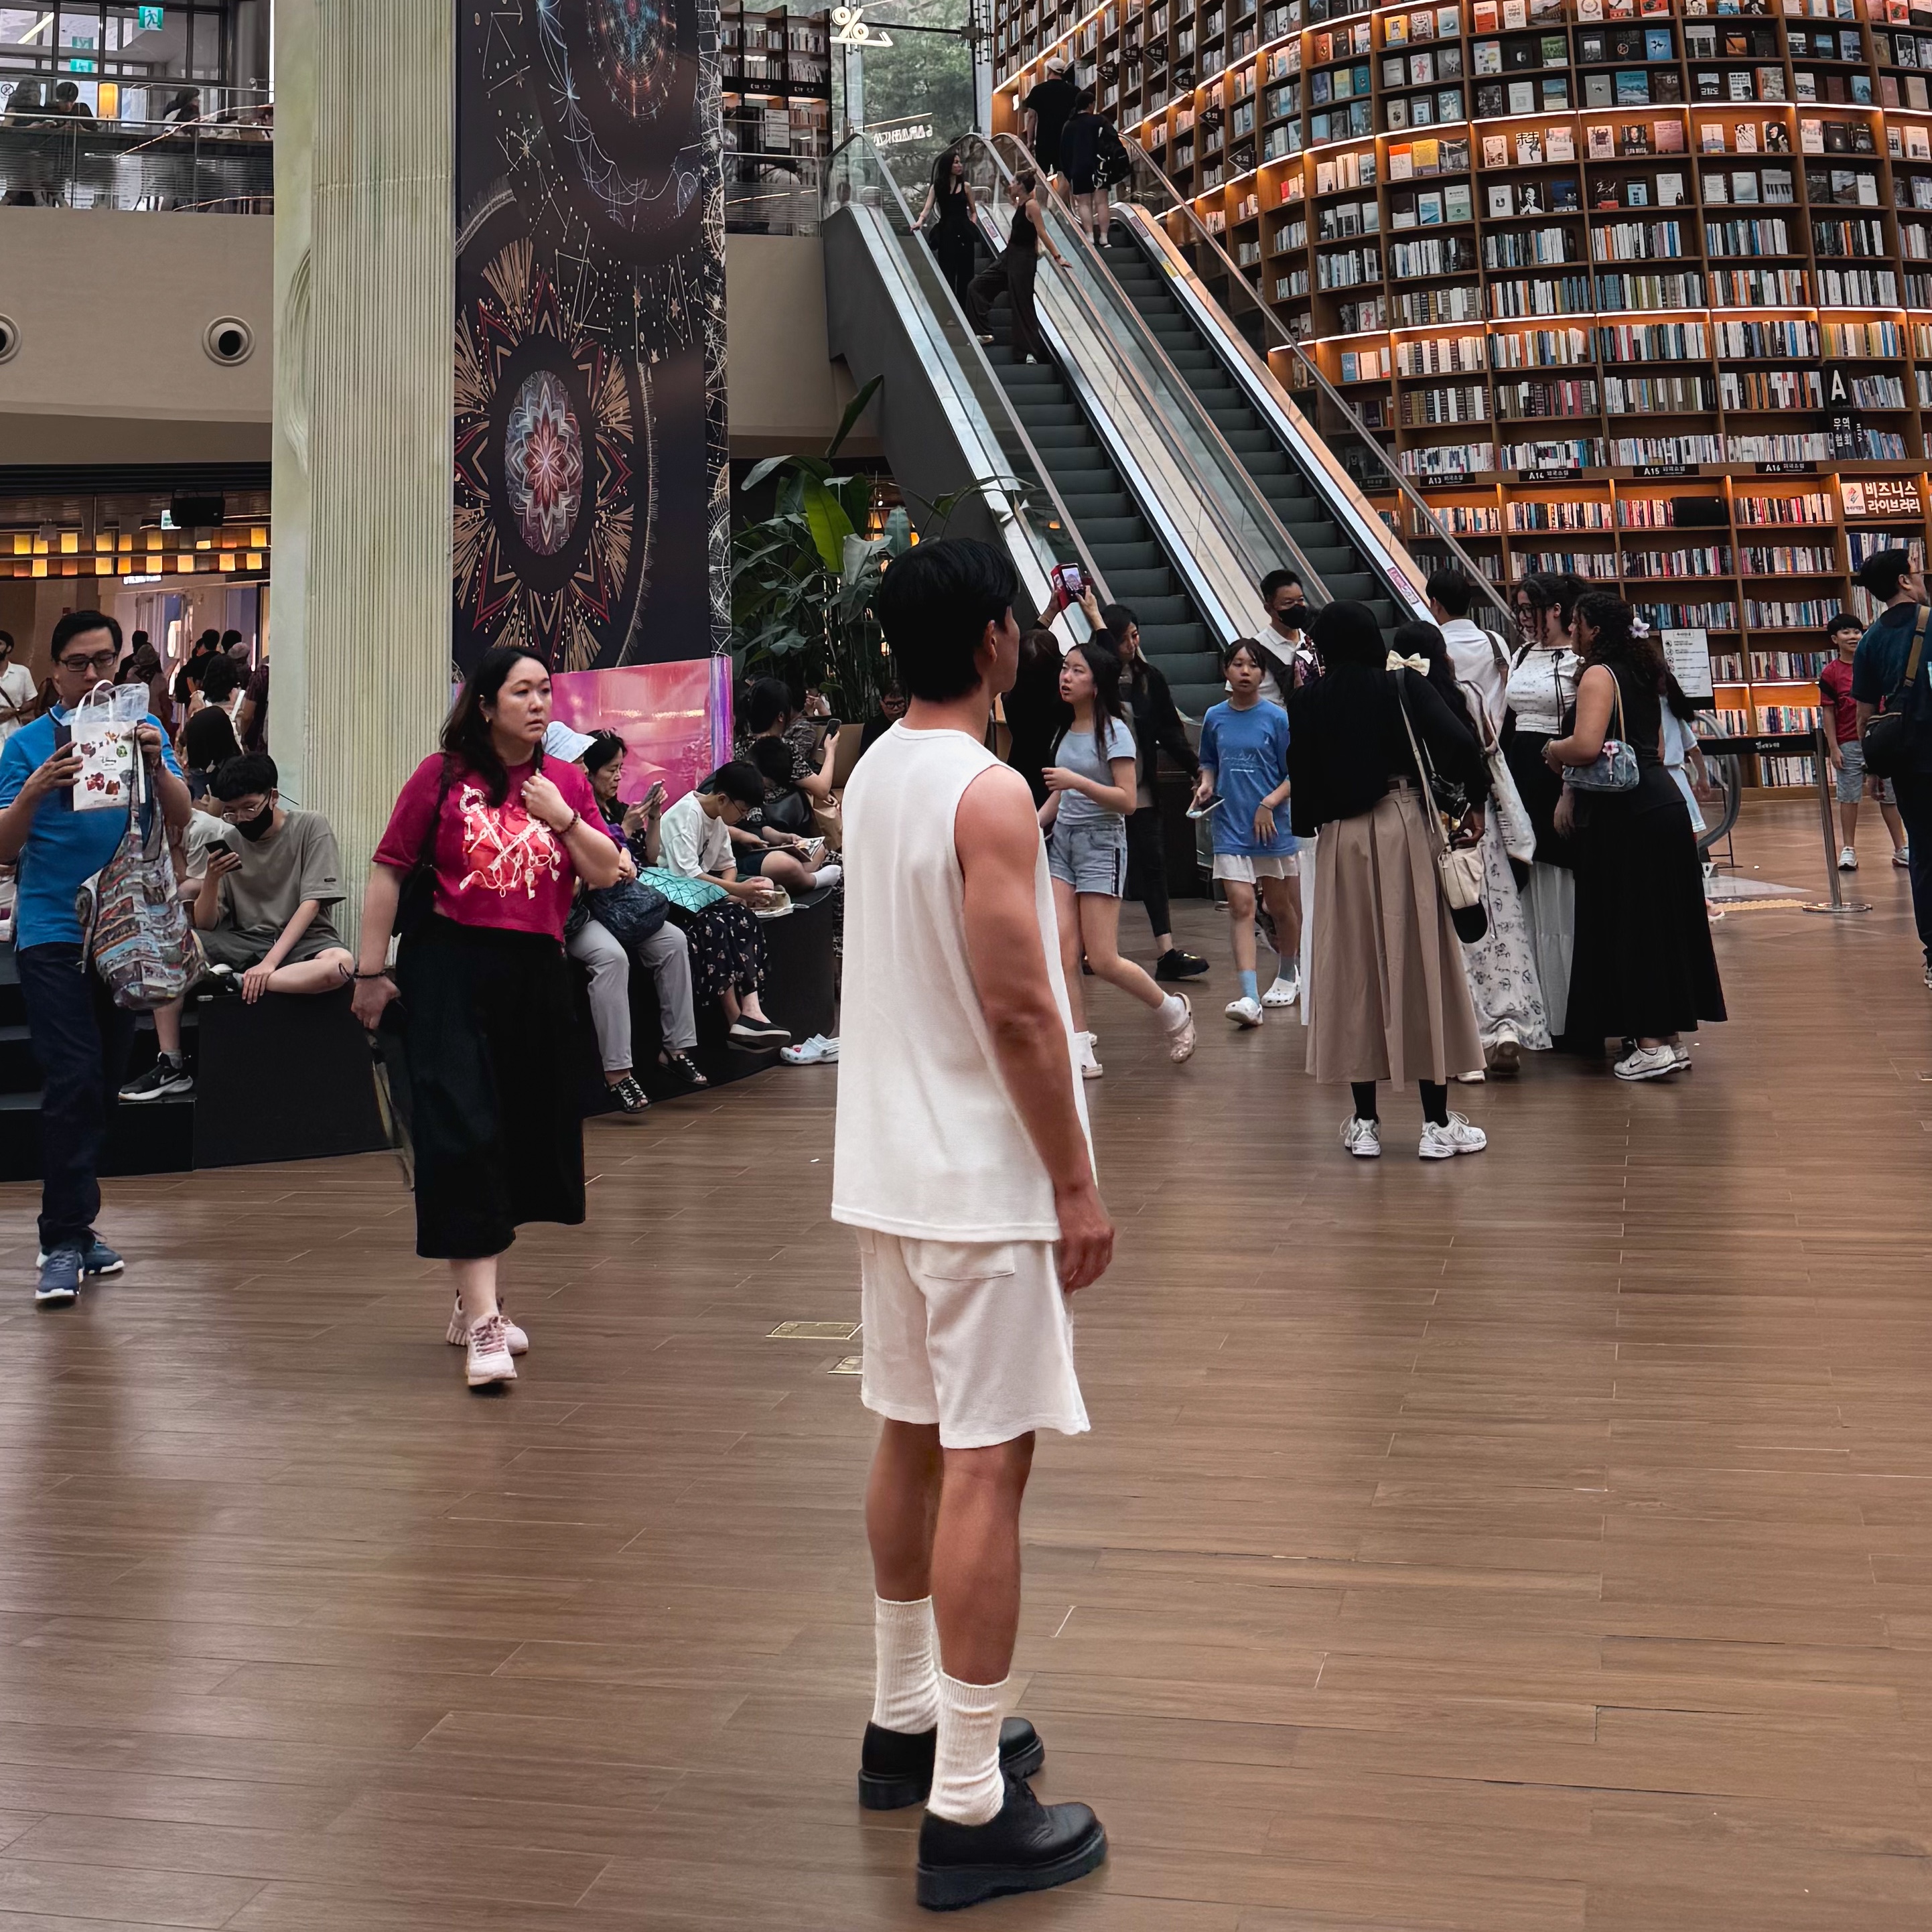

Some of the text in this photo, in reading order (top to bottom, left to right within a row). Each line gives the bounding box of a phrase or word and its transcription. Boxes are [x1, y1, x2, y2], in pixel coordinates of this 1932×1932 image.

[1831, 369, 1847, 401] A
[1834, 416, 1850, 430] 무역
[1644, 467, 1660, 476] A15
[1765, 464, 1781, 472] A16
[1428, 476, 1442, 485] A13
[1864, 480, 1918, 498] 비즈니스
[1867, 498, 1921, 514] 라이브러리
